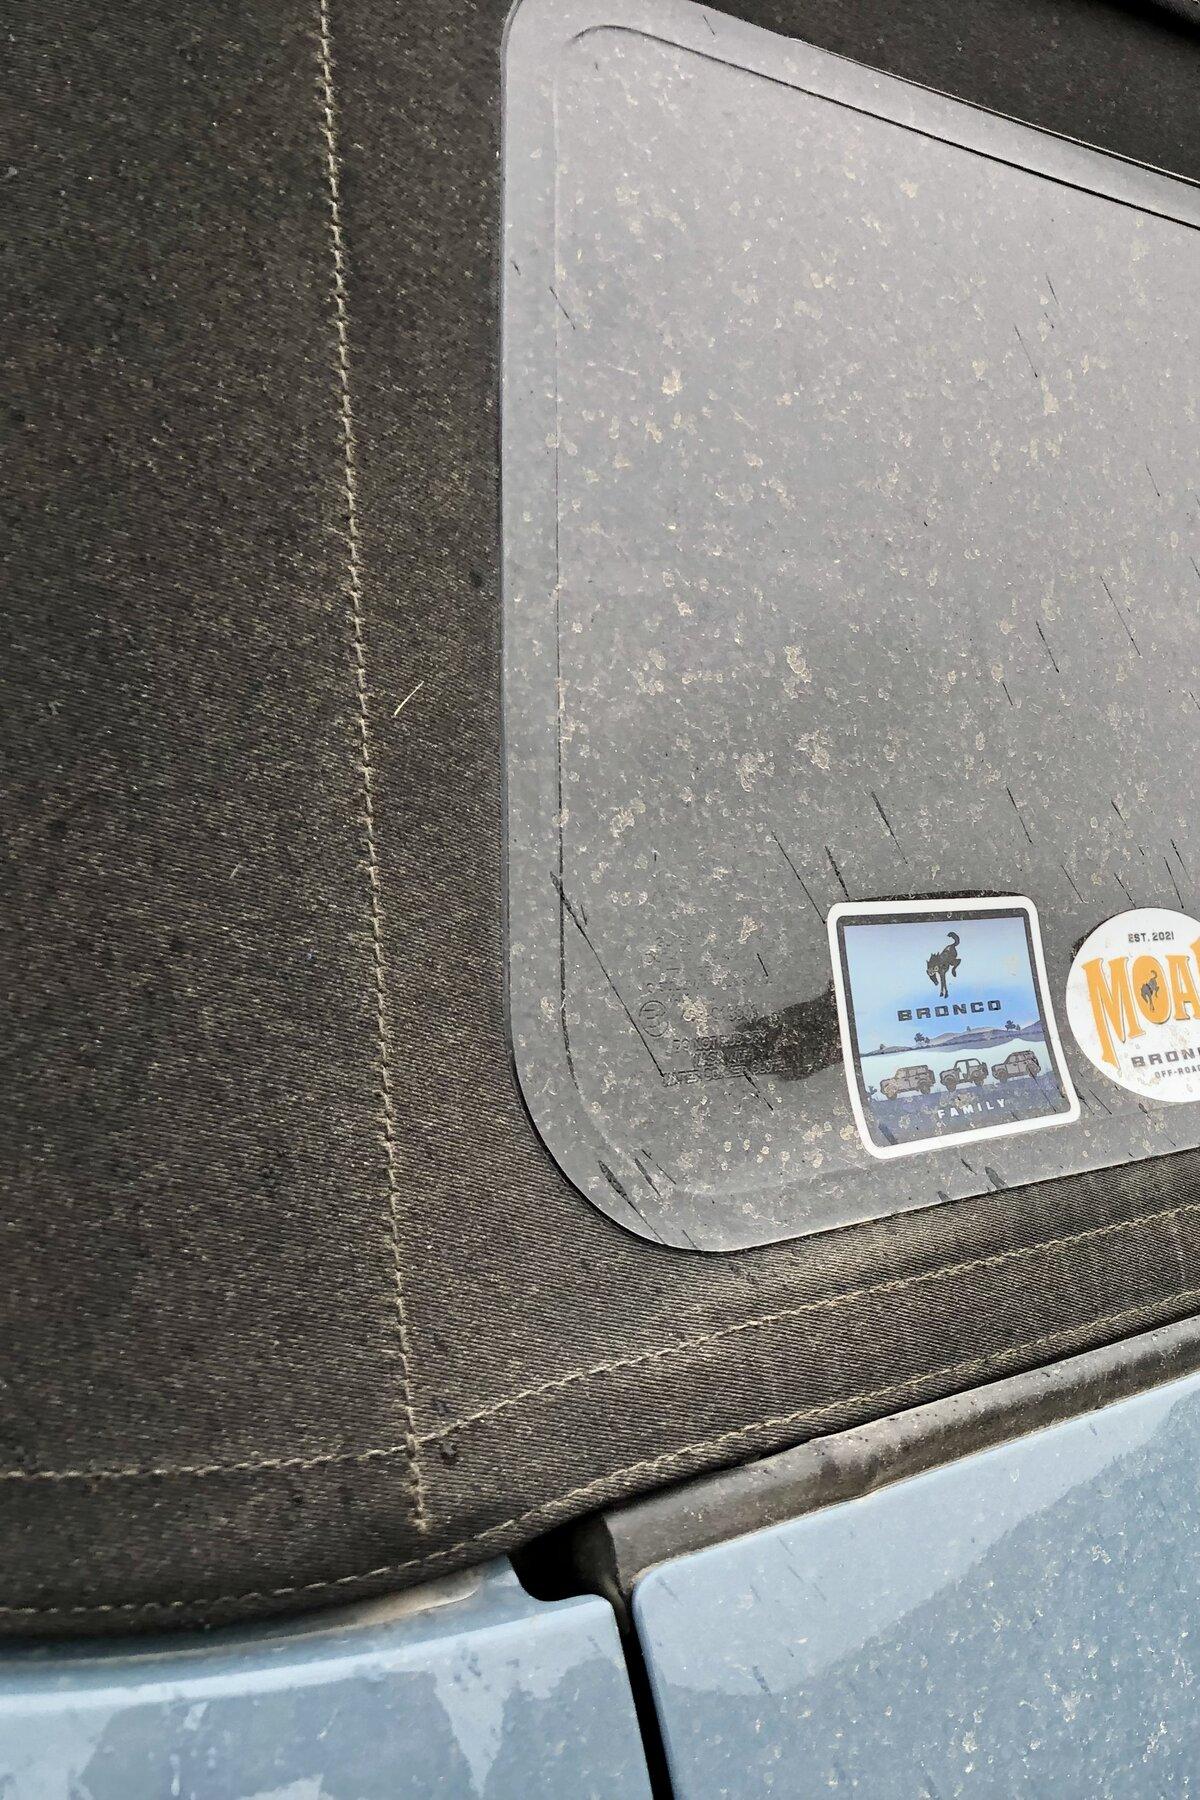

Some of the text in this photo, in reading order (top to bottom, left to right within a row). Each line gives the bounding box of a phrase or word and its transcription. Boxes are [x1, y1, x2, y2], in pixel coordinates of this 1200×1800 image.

[1152, 931, 1175, 942] 2021
[897, 1000, 1002, 1021] BRONCO
[937, 1098, 1006, 1119] FAMILY
